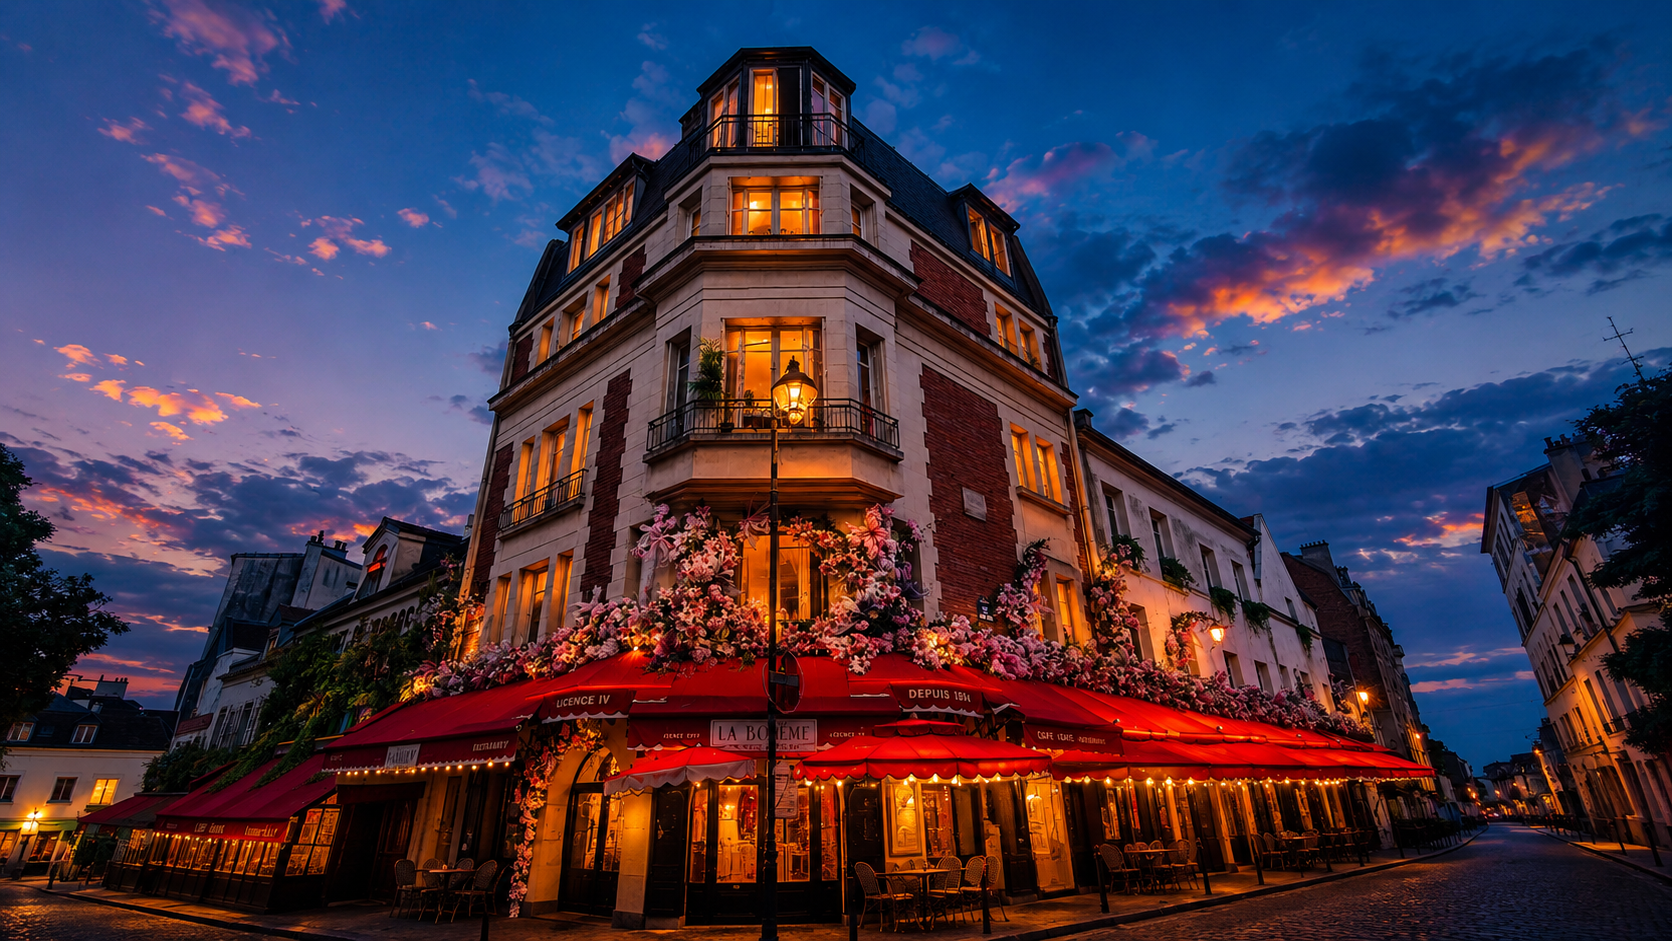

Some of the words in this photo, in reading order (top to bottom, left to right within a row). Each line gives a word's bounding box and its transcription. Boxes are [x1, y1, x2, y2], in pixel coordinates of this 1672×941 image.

[908, 688, 950, 699] DEPUIS
[556, 695, 595, 708] LICENCE
[598, 694, 610, 705] IV
[718, 725, 737, 741] LA
